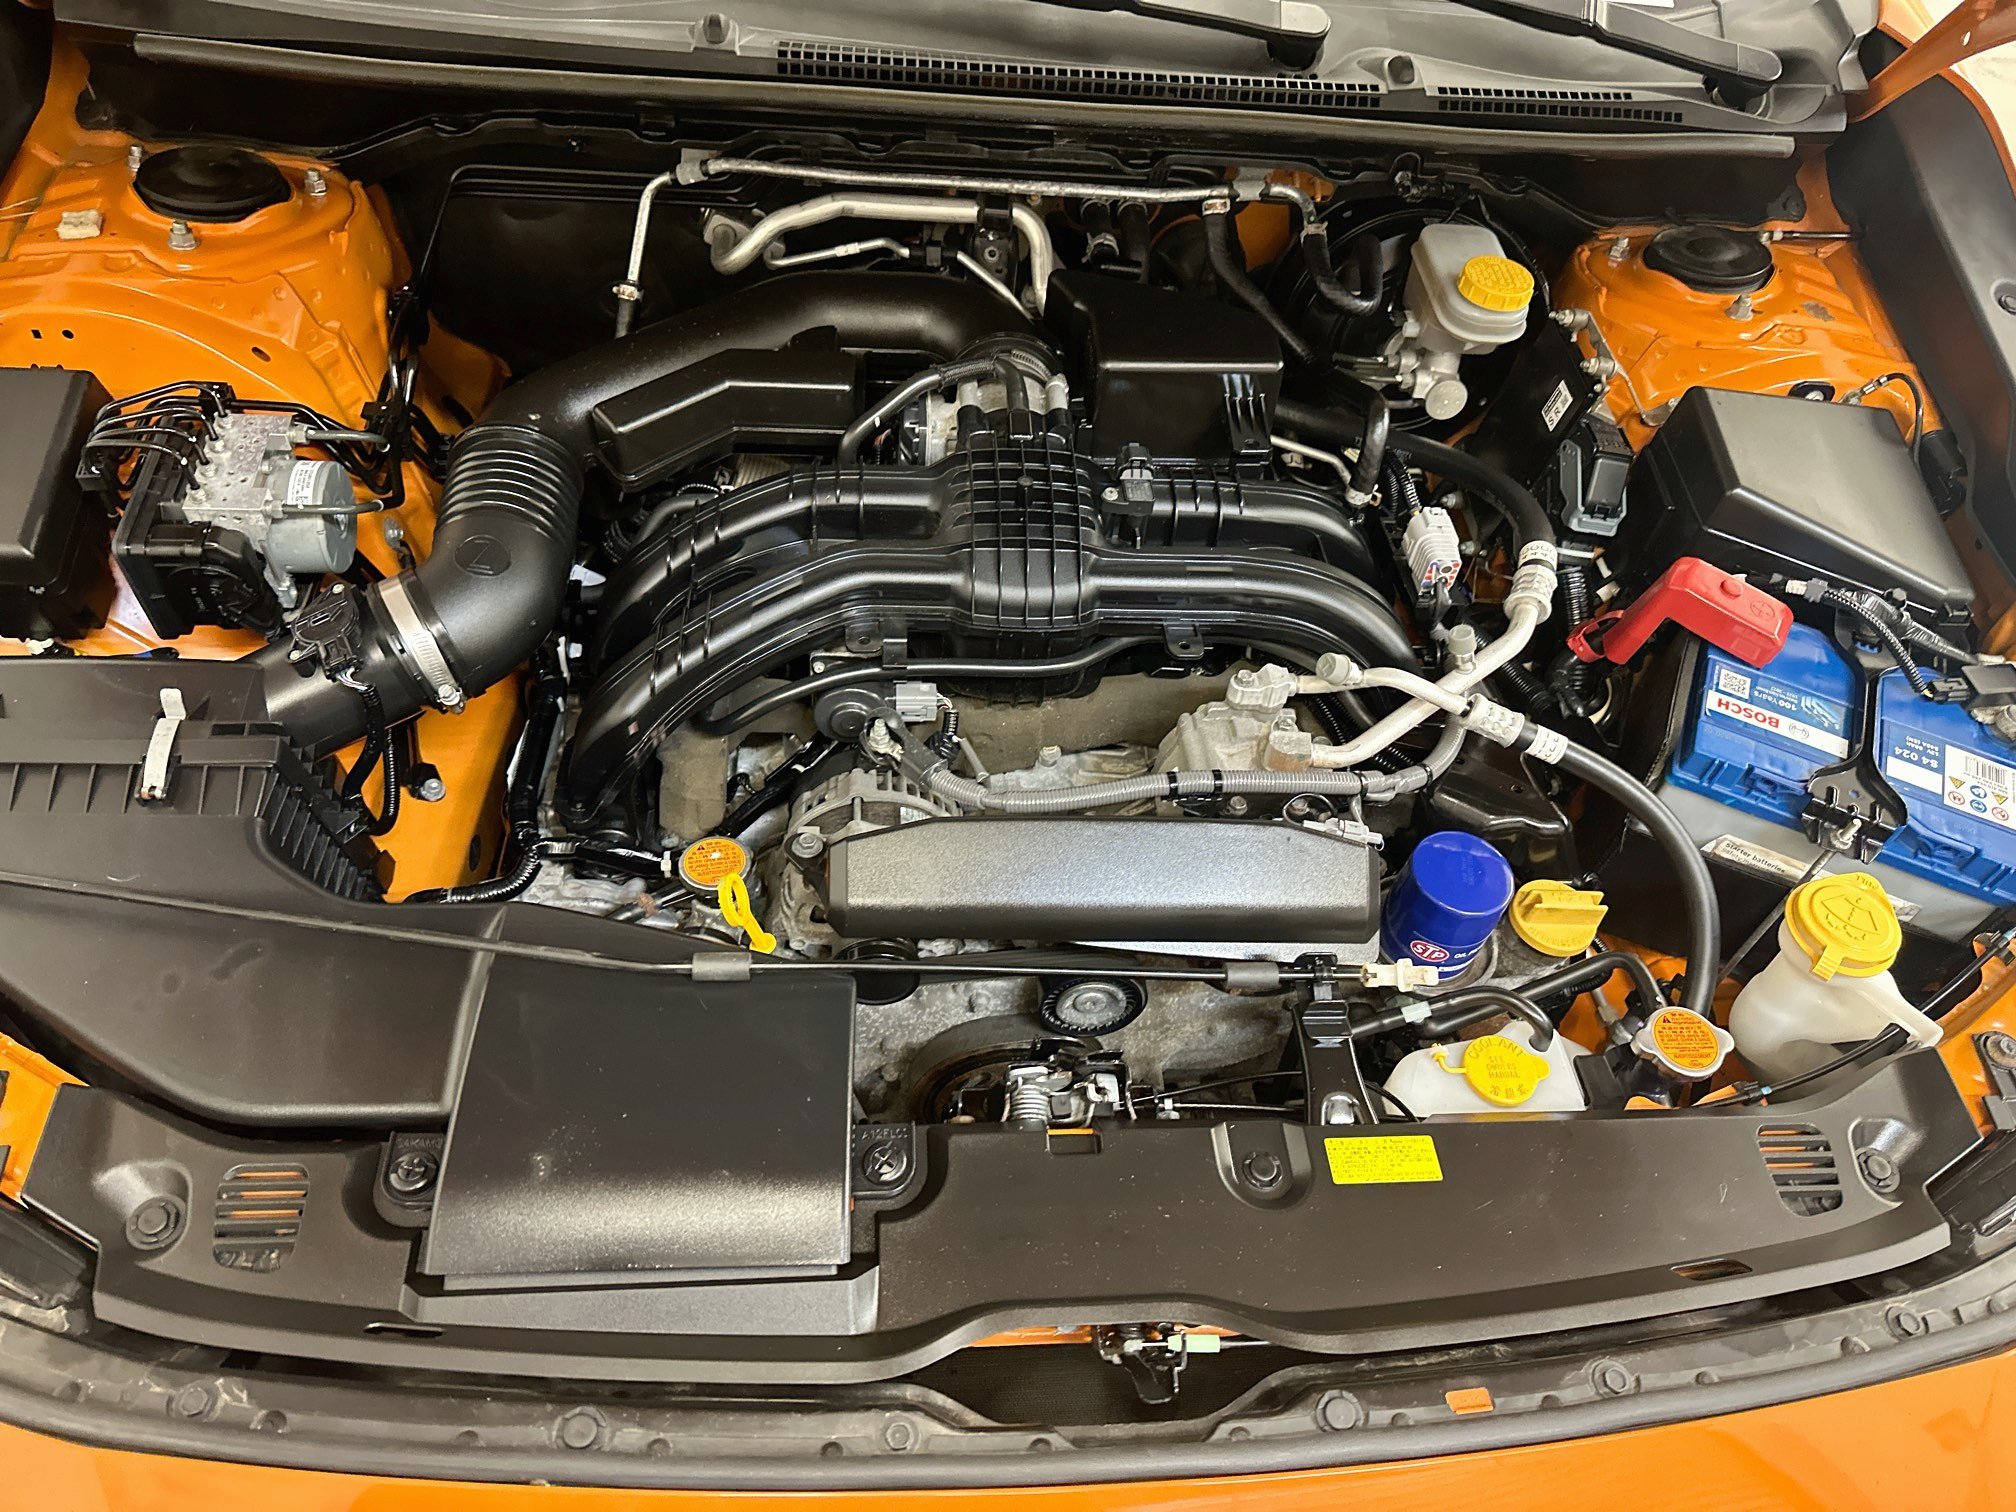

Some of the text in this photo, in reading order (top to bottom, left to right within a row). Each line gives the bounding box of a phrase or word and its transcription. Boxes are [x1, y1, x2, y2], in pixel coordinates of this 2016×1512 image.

[1752, 690, 1778, 706] Years
[1778, 700, 1798, 711] 100
[1717, 698, 1780, 728] BOSCH
[1894, 746, 1918, 761] 024
[1725, 842, 1752, 858] Starter
[1752, 855, 1786, 873] batteries
[1414, 944, 1446, 958] STP
